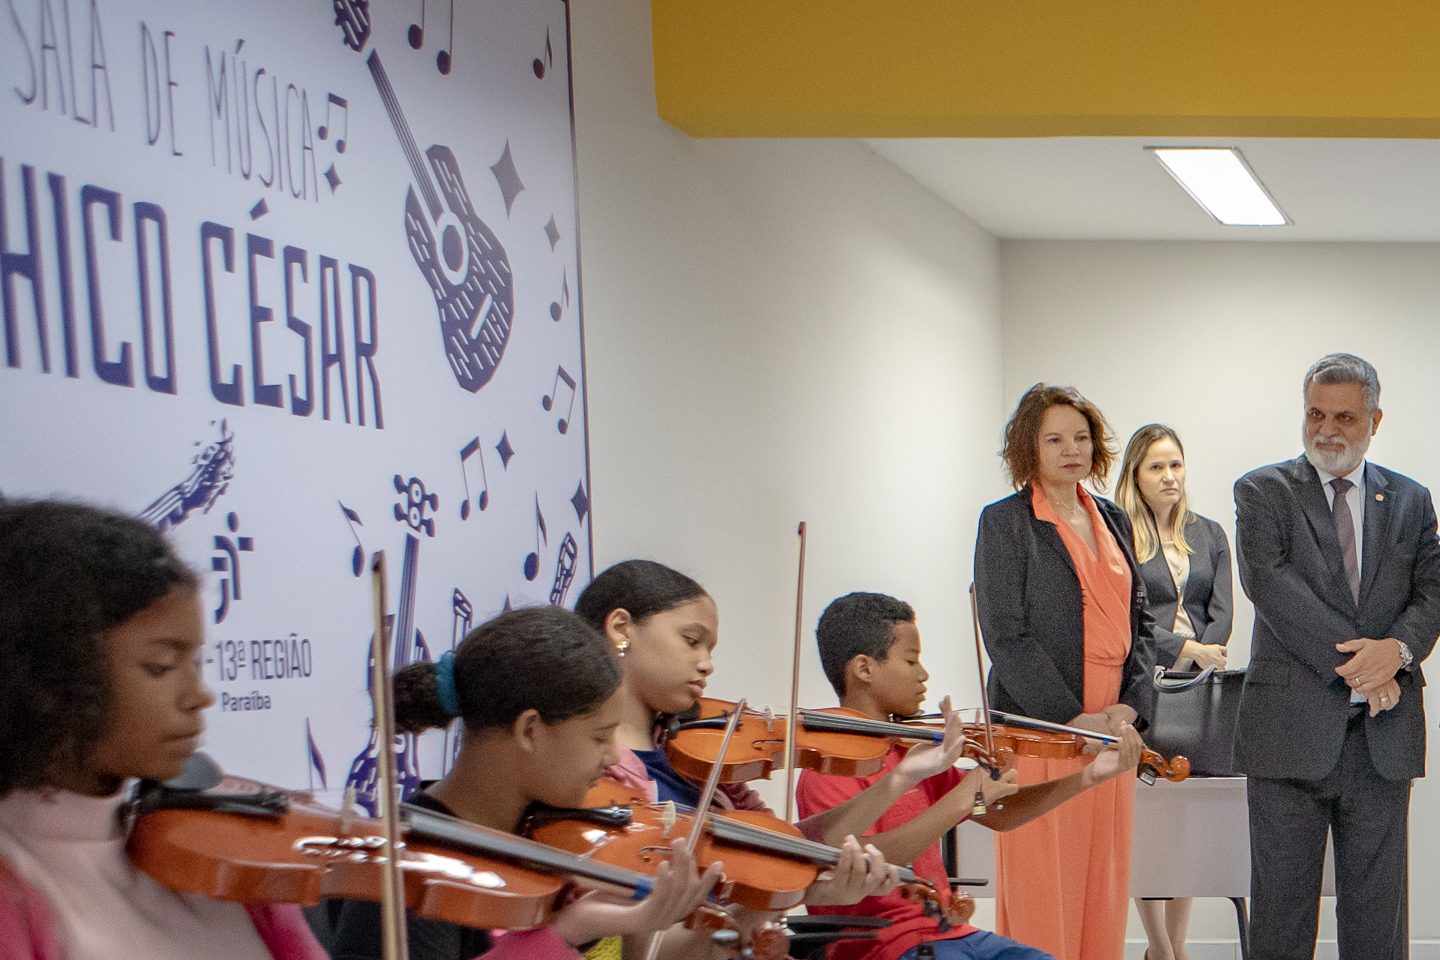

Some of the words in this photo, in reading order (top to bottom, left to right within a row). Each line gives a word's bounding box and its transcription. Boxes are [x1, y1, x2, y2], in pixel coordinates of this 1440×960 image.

[7, 0, 116, 132] SALA
[139, 20, 184, 157] DE
[204, 38, 319, 203] MÚSICA
[200, 197, 386, 430] CÉSAR
[221, 690, 272, 712] Paraíba
[251, 633, 312, 680] REGIÃO
